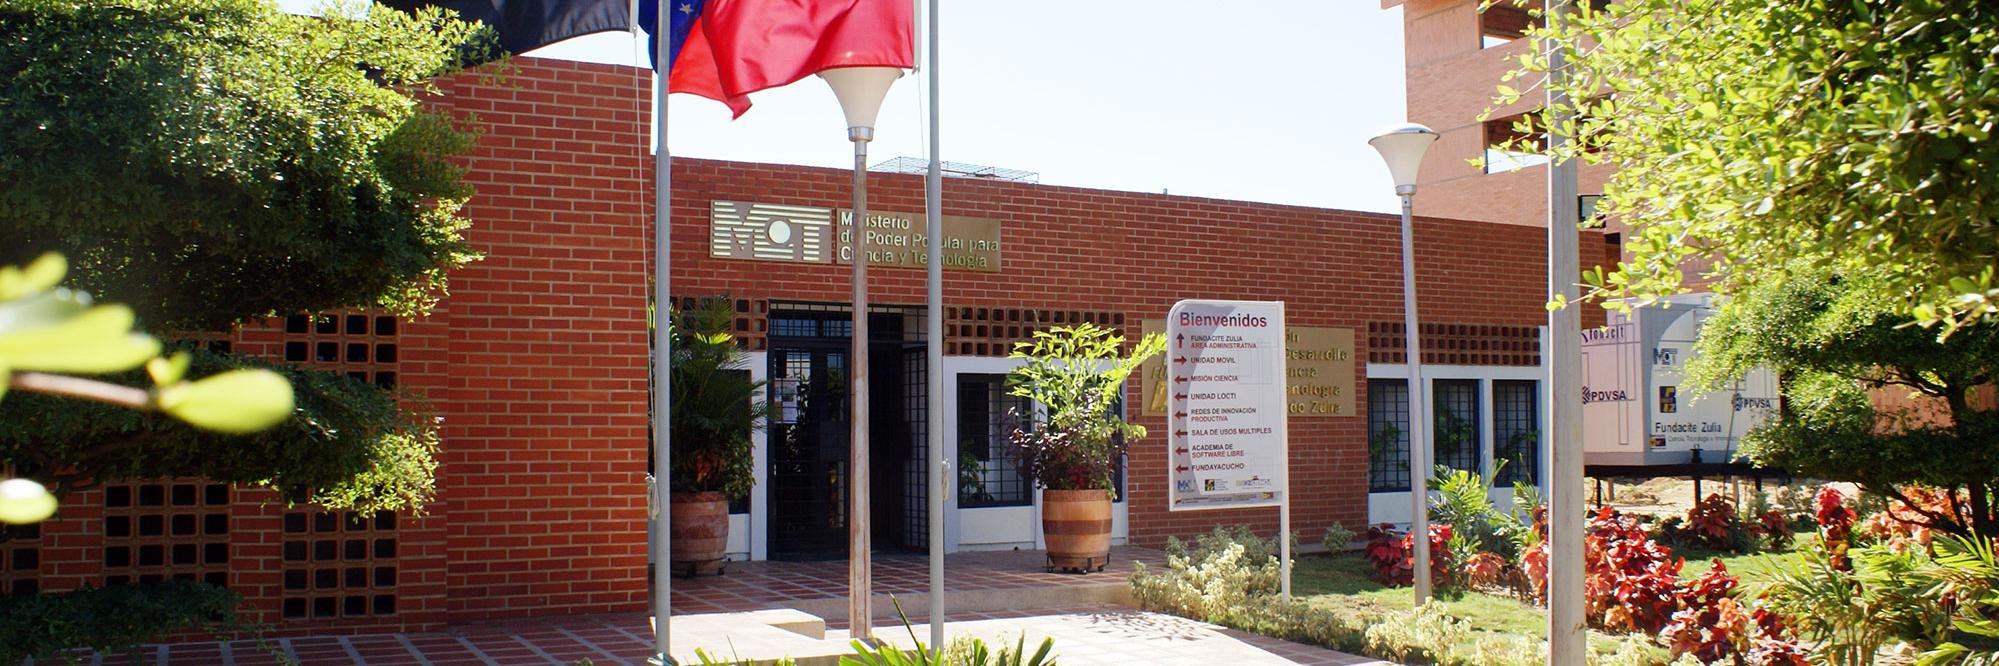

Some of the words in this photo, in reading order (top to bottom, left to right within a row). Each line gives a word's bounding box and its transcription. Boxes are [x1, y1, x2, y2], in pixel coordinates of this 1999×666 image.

[841, 211, 910, 229] Misterio
[866, 231, 908, 246] Poder
[912, 233, 964, 249] Poular
[969, 239, 999, 252] para
[841, 246, 894, 262] Cincia
[898, 253, 908, 265] y
[1180, 312, 1268, 328] Bienvenidos
[1591, 390, 1627, 401] PDVSA
[1744, 399, 1771, 408] PDVSA
[1655, 422, 1697, 432] Fundacite
[1701, 422, 1722, 432] Zulia
[1192, 450, 1226, 458] SOFTWARE
[1191, 462, 1245, 471] FUNDAYACUCHO
